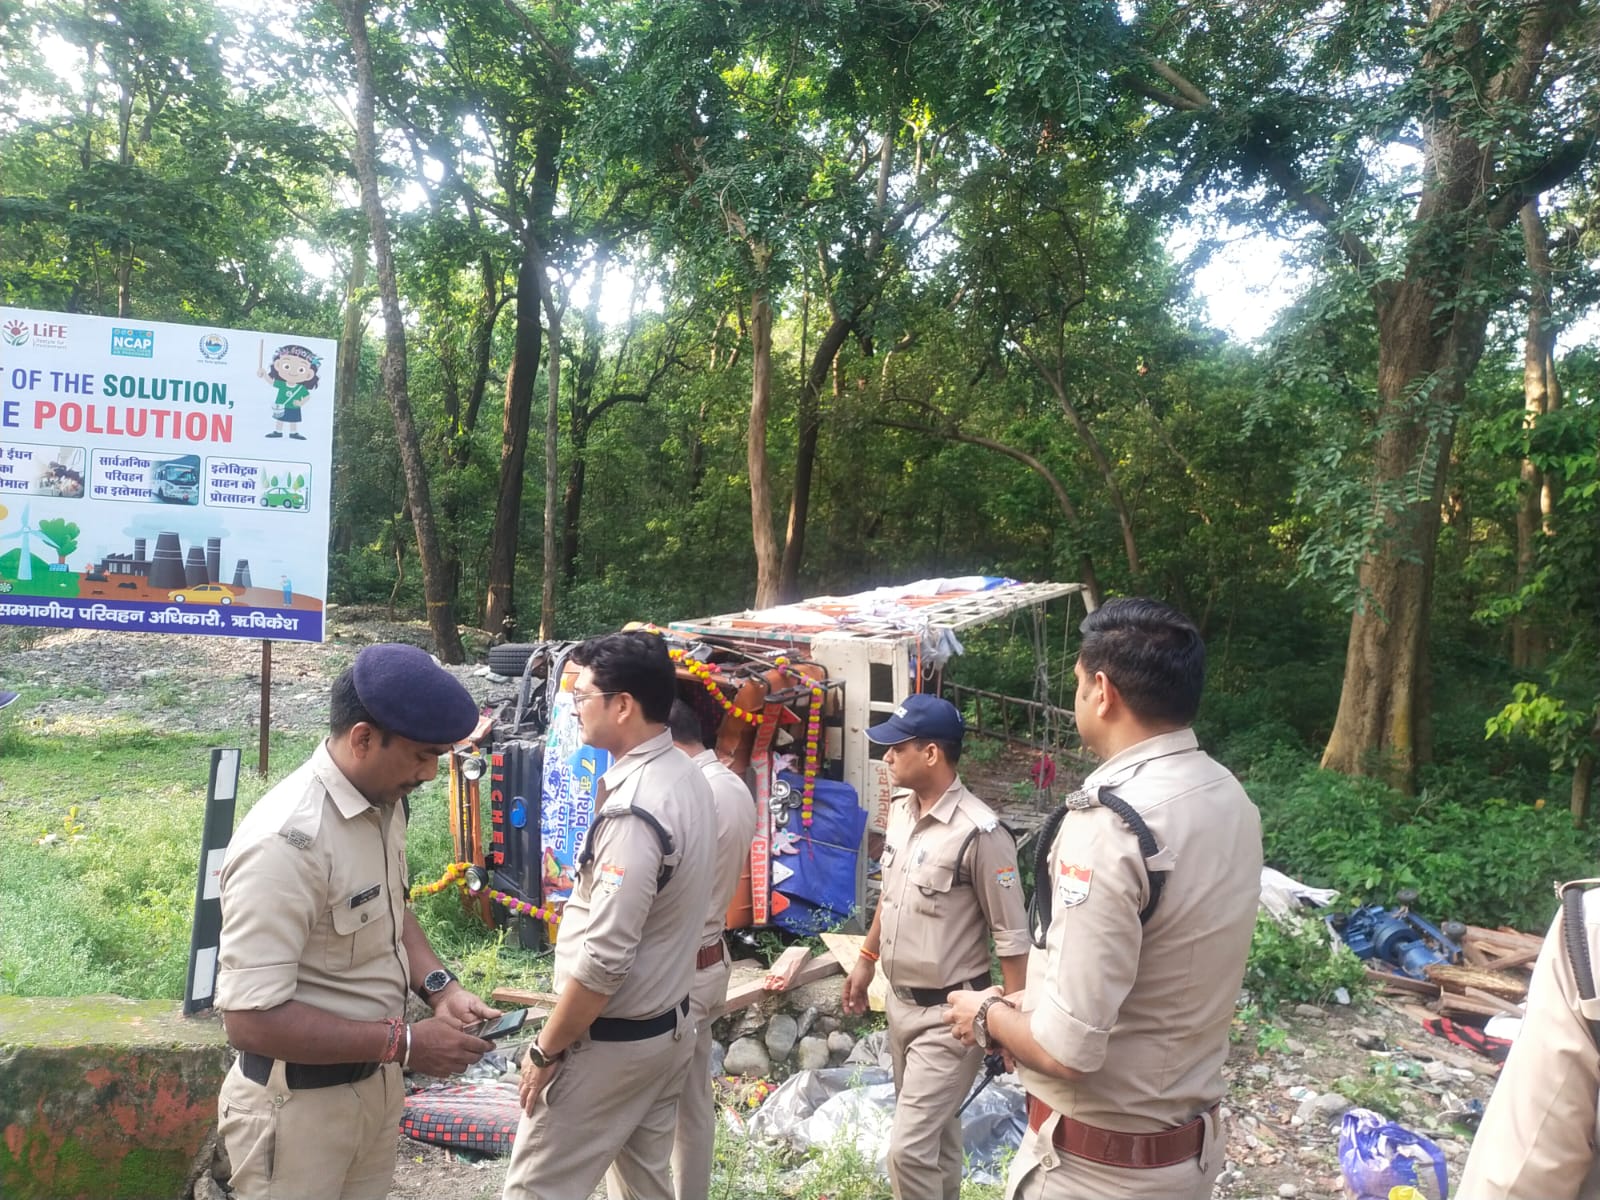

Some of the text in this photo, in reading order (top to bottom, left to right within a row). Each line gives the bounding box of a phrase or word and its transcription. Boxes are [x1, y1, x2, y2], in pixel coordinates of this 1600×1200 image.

[33, 323, 68, 339] LiFE
[113, 336, 152, 350] NCAP
[12, 368, 234, 409] OF THE SOLUTION,
[34, 400, 233, 443] POLLUTION
[99, 454, 151, 468] सार्वजनिक
[105, 469, 144, 482] परिवहन
[94, 484, 153, 498] का इस्तेमाल
[211, 478, 257, 490] वाहन को
[210, 490, 257, 504] प्रोत्साहन
[79, 603, 146, 624] परिवहन
[148, 606, 226, 628] अधिकारी,
[231, 611, 300, 631] ऋषिकेश
[491, 754, 505, 865] EICHER
[751, 840, 767, 925] CARRIER
